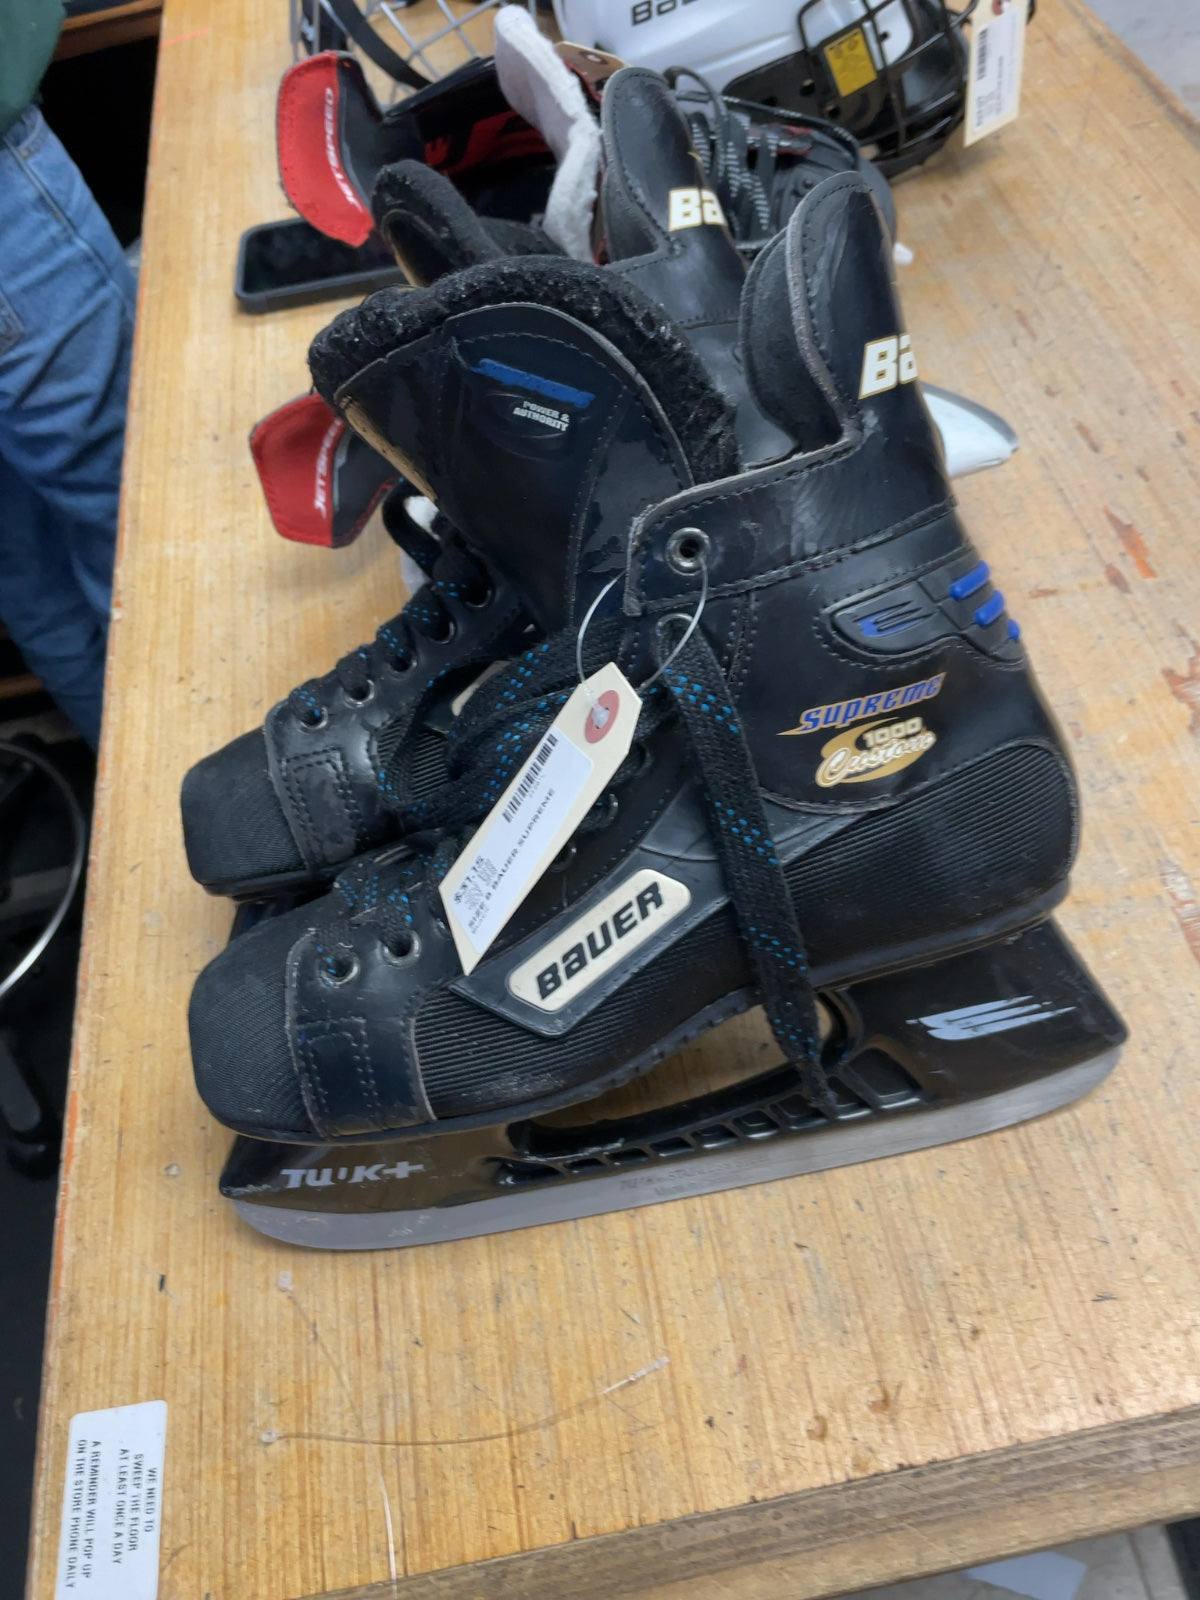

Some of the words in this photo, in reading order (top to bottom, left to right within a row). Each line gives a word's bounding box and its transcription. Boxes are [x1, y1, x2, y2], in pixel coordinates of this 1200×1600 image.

[512, 407, 569, 431] AUTHORITY
[523, 400, 560, 418] POWER
[560, 413, 570, 423] &
[800, 674, 944, 732] SUPREME
[862, 717, 923, 748] 1000
[491, 848, 518, 890] BAUER
[518, 787, 555, 847] SUPREME
[77, 1439, 88, 1454] ON
[91, 1440, 101, 1448] A
[119, 1448, 130, 1461] AT
[75, 1457, 85, 1476] THE
[87, 1451, 101, 1506] REMINDER
[132, 1453, 144, 1489] SWEEP
[147, 1467, 157, 1484] WE
[116, 1465, 129, 1496] LEAST
[72, 1479, 84, 1513] STORE
[130, 1492, 141, 1514] THE
[145, 1487, 156, 1515] NEED
[84, 1508, 96, 1534] WILL
[114, 1500, 126, 1526] ONCE
[68, 1517, 81, 1552] PHONE
[114, 1531, 124, 1539] A
[127, 1517, 140, 1552] FLOOR
[144, 1520, 155, 1533] TO
[82, 1538, 94, 1559] POP
[112, 1542, 124, 1565] DAY
[65, 1556, 78, 1588] DAILY
[81, 1563, 92, 1579] UP
